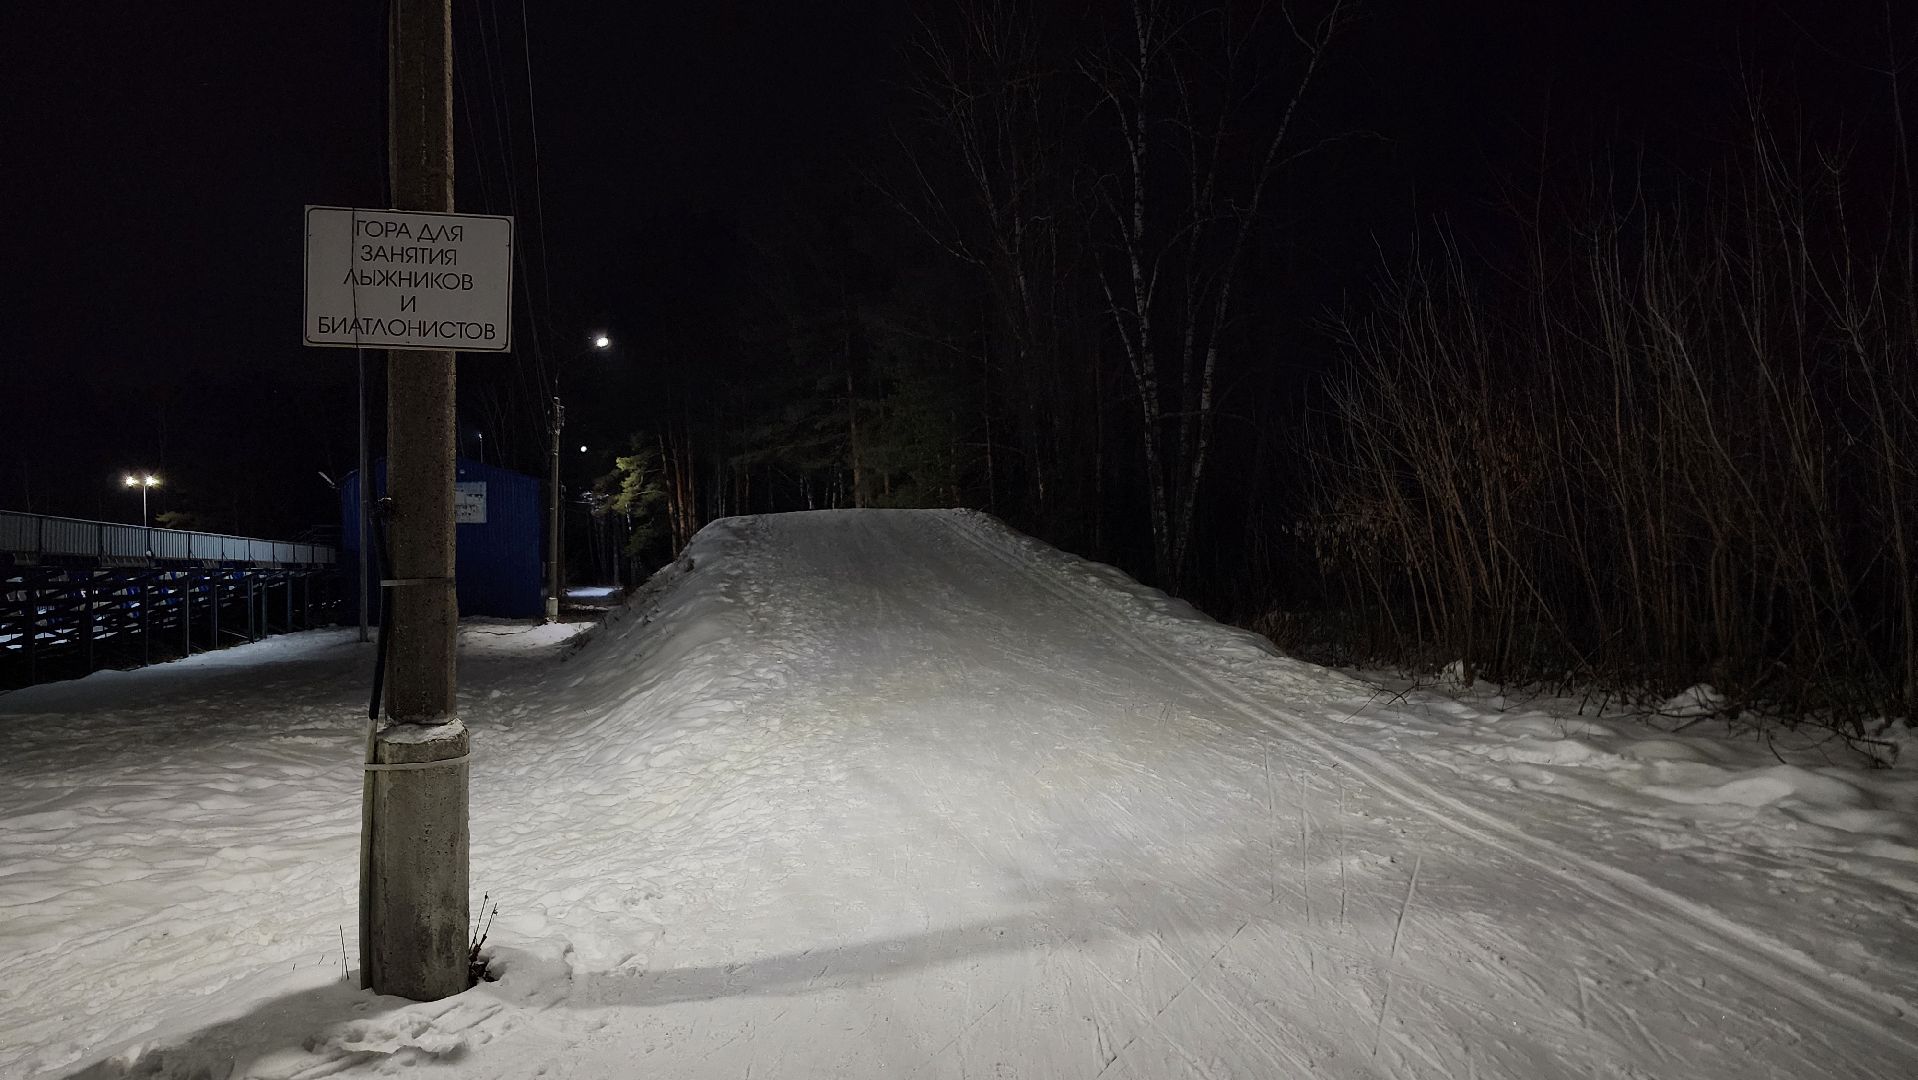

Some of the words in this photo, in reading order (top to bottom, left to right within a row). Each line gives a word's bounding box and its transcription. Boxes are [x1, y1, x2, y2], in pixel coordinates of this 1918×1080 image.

[356, 220, 412, 239] ГОРА
[417, 224, 463, 243] ДЛЯ
[360, 244, 457, 266] ЗАНЯТИЯ
[343, 268, 473, 291] ЛЫЖНИКОВ
[401, 295, 416, 313] И
[318, 316, 496, 340] БИАТЛОНИСТОВ
